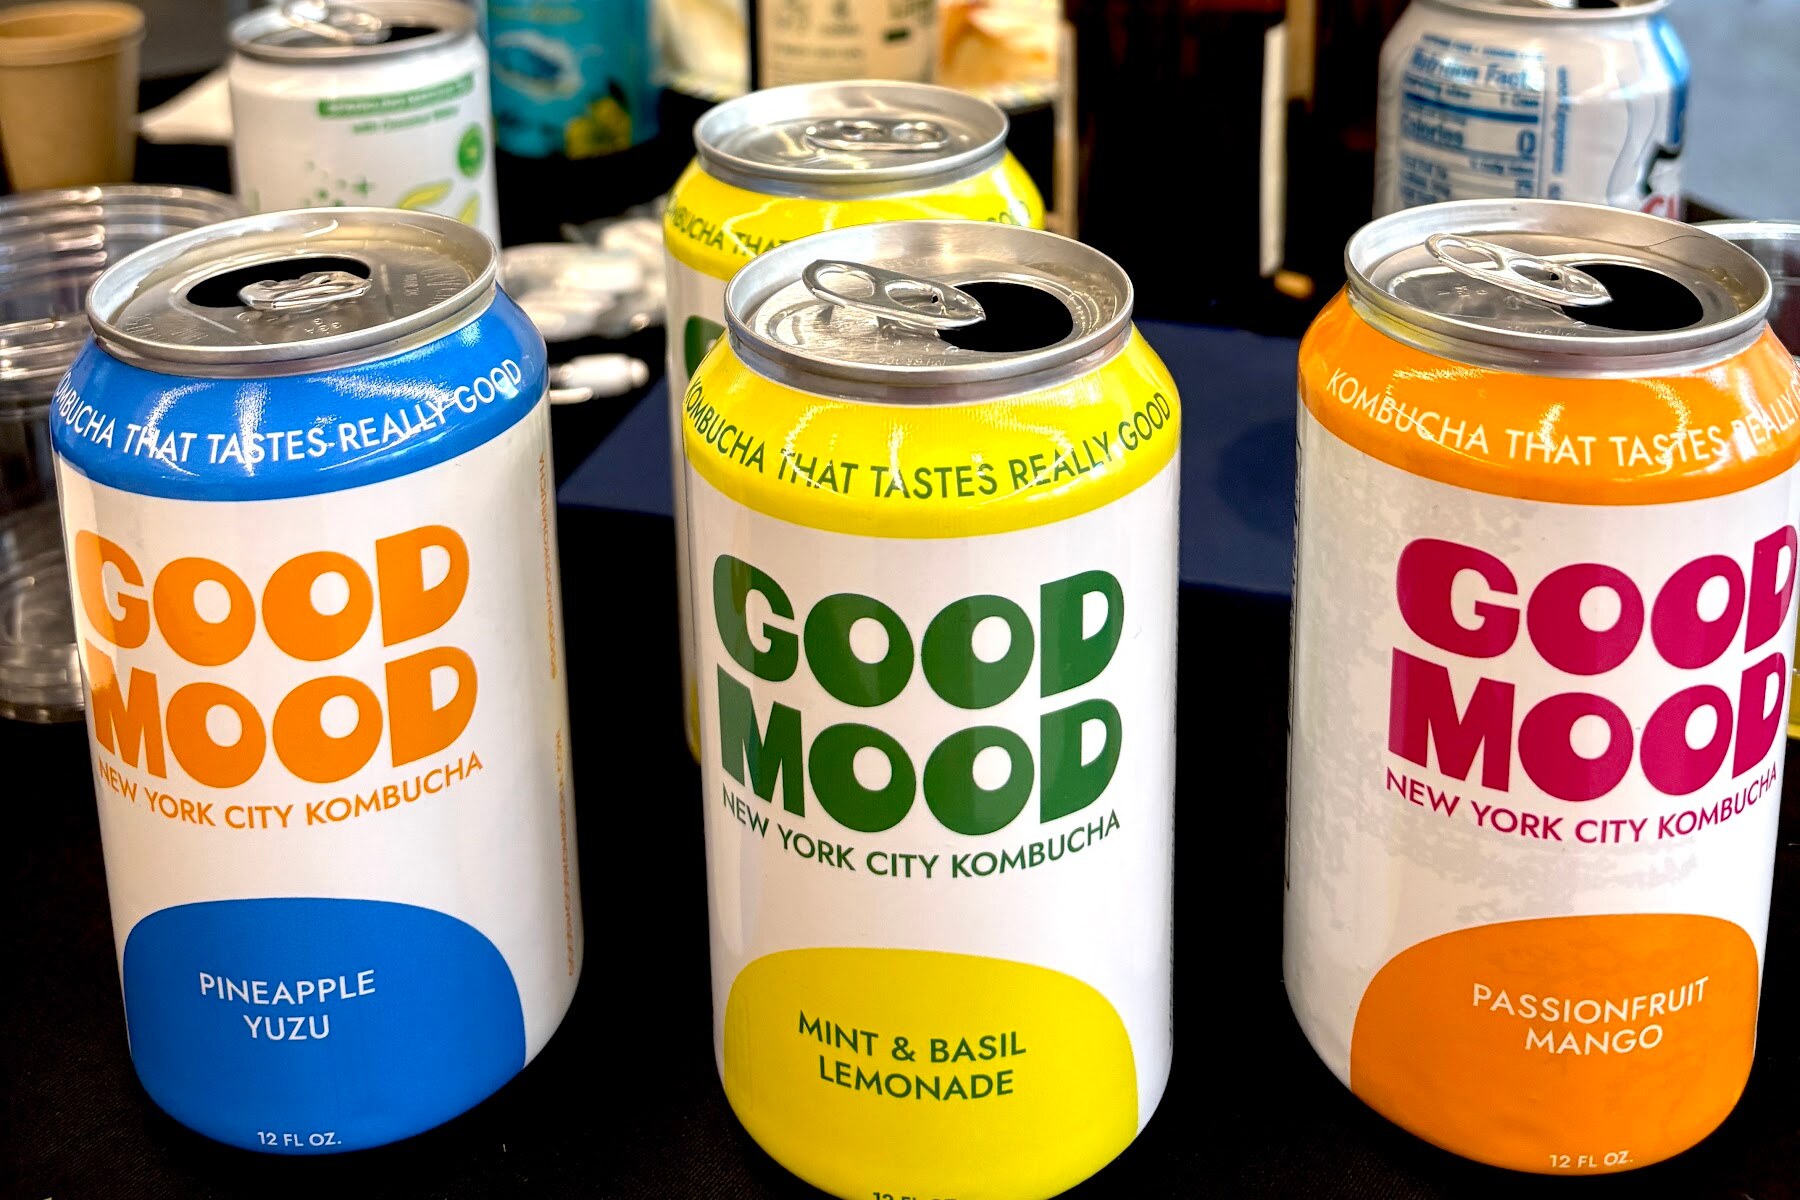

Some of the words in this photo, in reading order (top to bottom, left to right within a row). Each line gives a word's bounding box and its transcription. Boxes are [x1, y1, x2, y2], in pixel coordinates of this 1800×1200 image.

[733, 231, 790, 256] THA
[55, 371, 116, 449] OMBUCHA
[124, 423, 198, 464] THAT
[207, 427, 327, 465] TASTES
[338, 398, 450, 452] REALLY
[454, 359, 522, 413] GOOD
[686, 376, 765, 474] KOMBUCHA
[778, 449, 859, 494] THAT
[871, 463, 998, 499] TASTES
[1008, 431, 1112, 491] REALLY
[1118, 392, 1171, 451] GOOD
[1326, 368, 1489, 454] KOMBUCHA
[1505, 428, 1597, 467] THAT
[1609, 425, 1728, 467] TASTES
[74, 525, 471, 667] GOOD
[712, 553, 1126, 710] GOOD
[1396, 524, 1798, 677] GOOD
[84, 645, 479, 788] MOOD
[716, 662, 1123, 836] MOOD
[1388, 646, 1787, 802] MOOD
[98, 756, 138, 803] NEW
[144, 787, 216, 827] YORK
[224, 804, 293, 829] CITY
[306, 751, 483, 826] KOMBUCHA
[722, 782, 770, 839] NEW
[777, 822, 856, 871] YORK
[866, 850, 939, 879] CITY
[952, 808, 1121, 878] KOMBUCHA
[1386, 766, 1460, 817] NEW
[1470, 800, 1563, 841] YORK
[1574, 817, 1648, 843] CITY
[1657, 762, 1778, 839] KOMBUCHA
[199, 969, 376, 1006] PINEAPPLE
[243, 1014, 330, 1040] YUZU
[1472, 976, 1709, 1024] PASSIONFRUIT
[798, 1009, 879, 1057] MINT
[891, 1035, 916, 1062] &
[930, 1030, 1027, 1063] BASIL
[1524, 1023, 1664, 1055] MANGO
[819, 1054, 1013, 1101] LEMONADE
[257, 1131, 278, 1146] 12
[283, 1133, 304, 1147] FL
[309, 1131, 342, 1147] OZ.
[1549, 1154, 1571, 1168] 12
[1577, 1154, 1598, 1168] FL
[1603, 1150, 1634, 1167] OZ.
